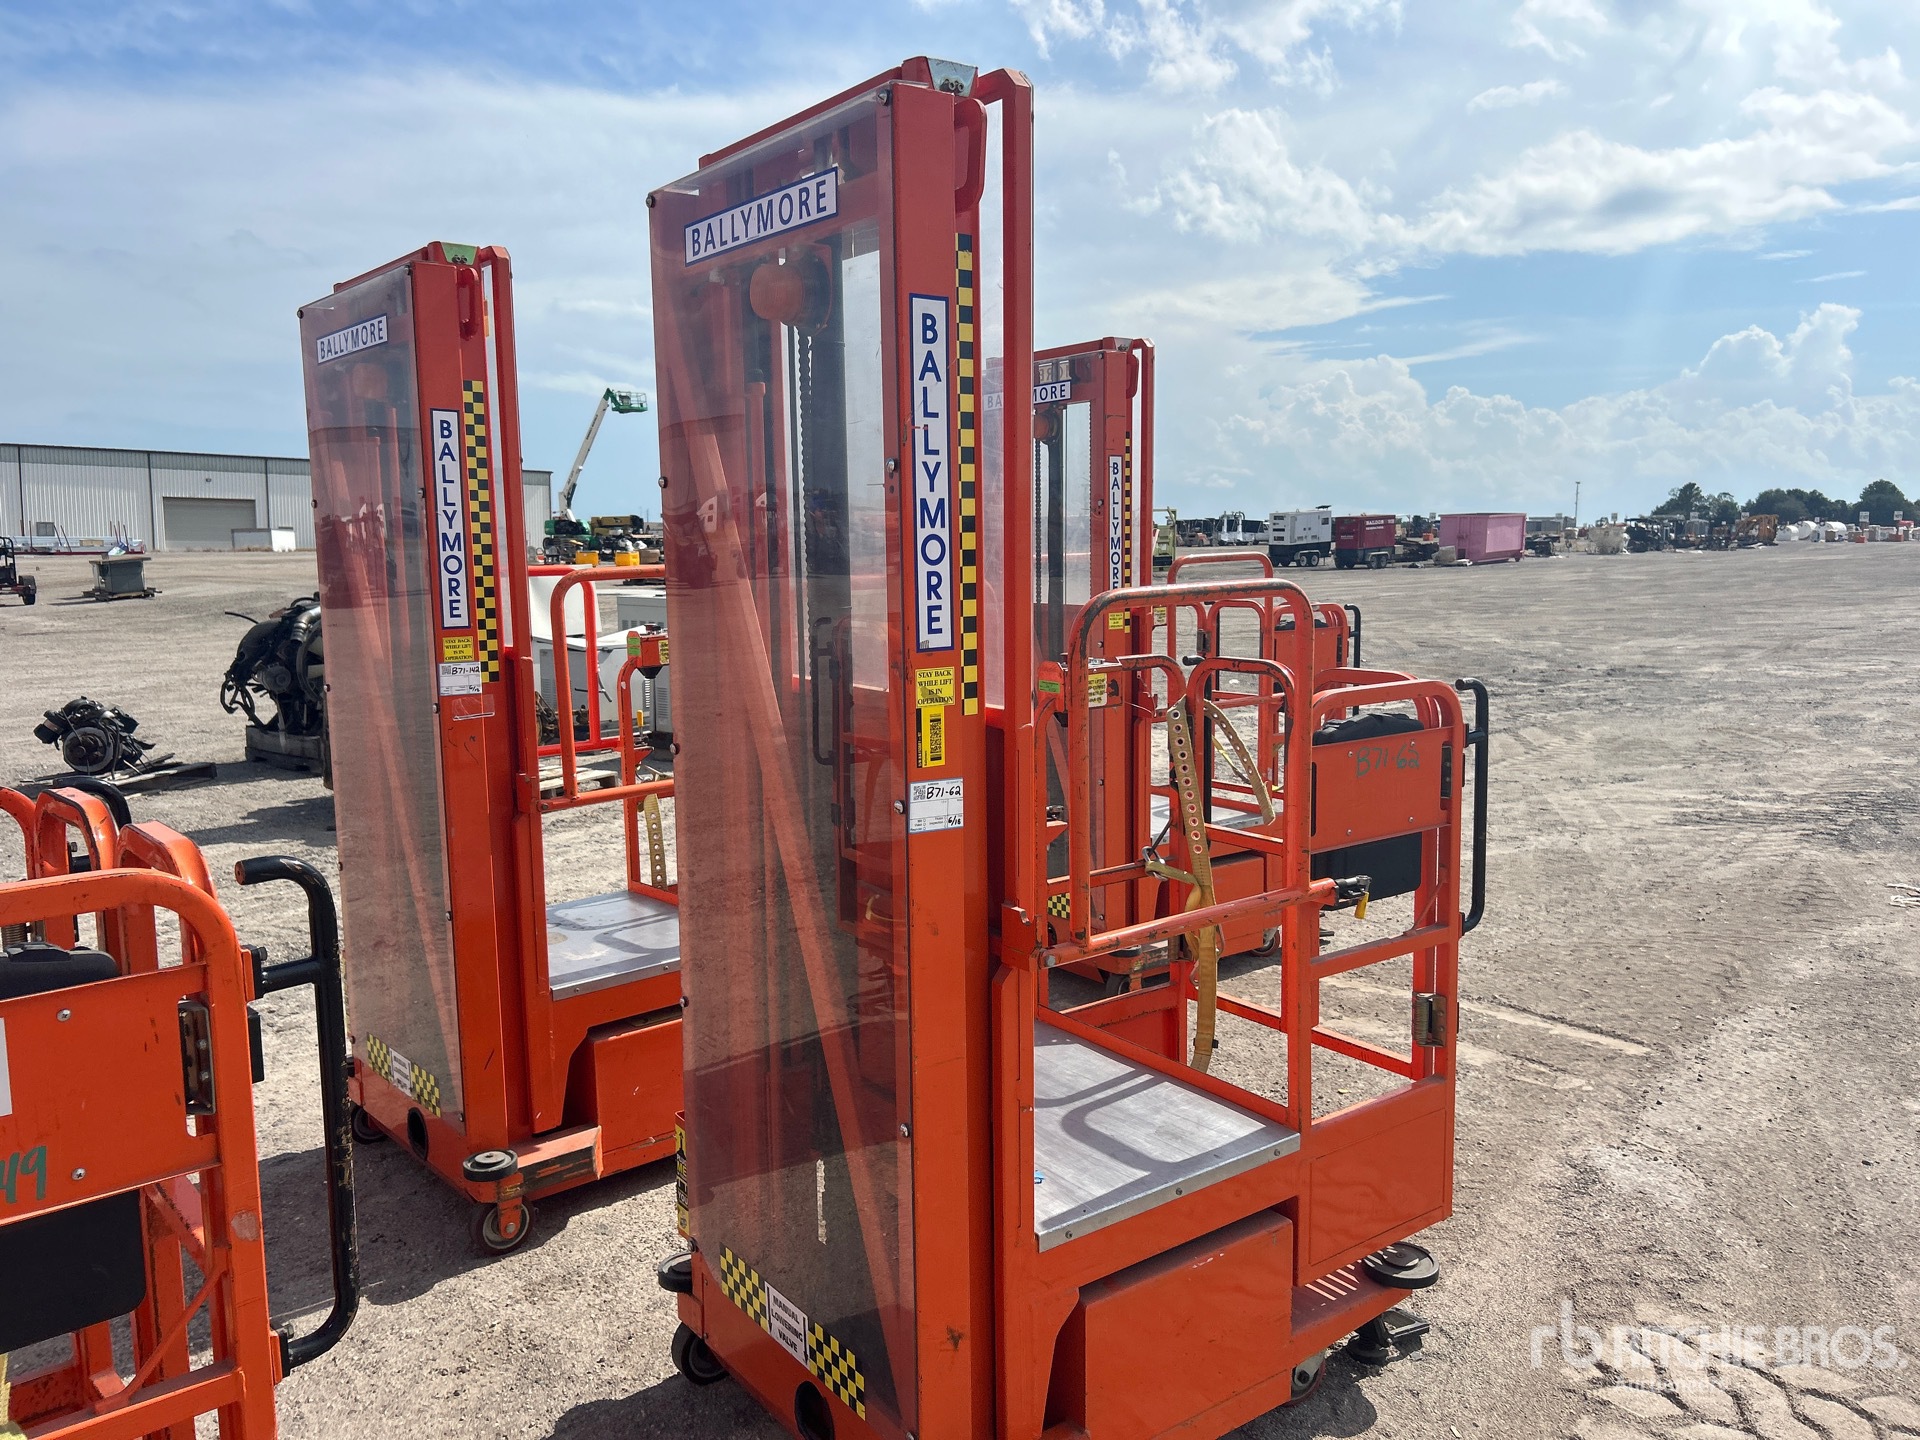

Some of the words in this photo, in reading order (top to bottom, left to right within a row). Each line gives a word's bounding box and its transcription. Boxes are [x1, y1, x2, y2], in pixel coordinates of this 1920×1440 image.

[692, 179, 827, 257] BALLYMORE
[320, 319, 384, 360] BALLYMORE
[918, 312, 946, 635] BALLYMORE
[438, 419, 463, 619] BALLYMORE
[917, 679, 938, 687] WHILE
[935, 669, 952, 677] BACK
[917, 696, 953, 705] OPERATION
[926, 785, 961, 799] B71-62
[772, 1295, 800, 1325] MANUAL
[771, 1308, 803, 1343] LOWERING
[777, 1328, 798, 1353] VALVE
